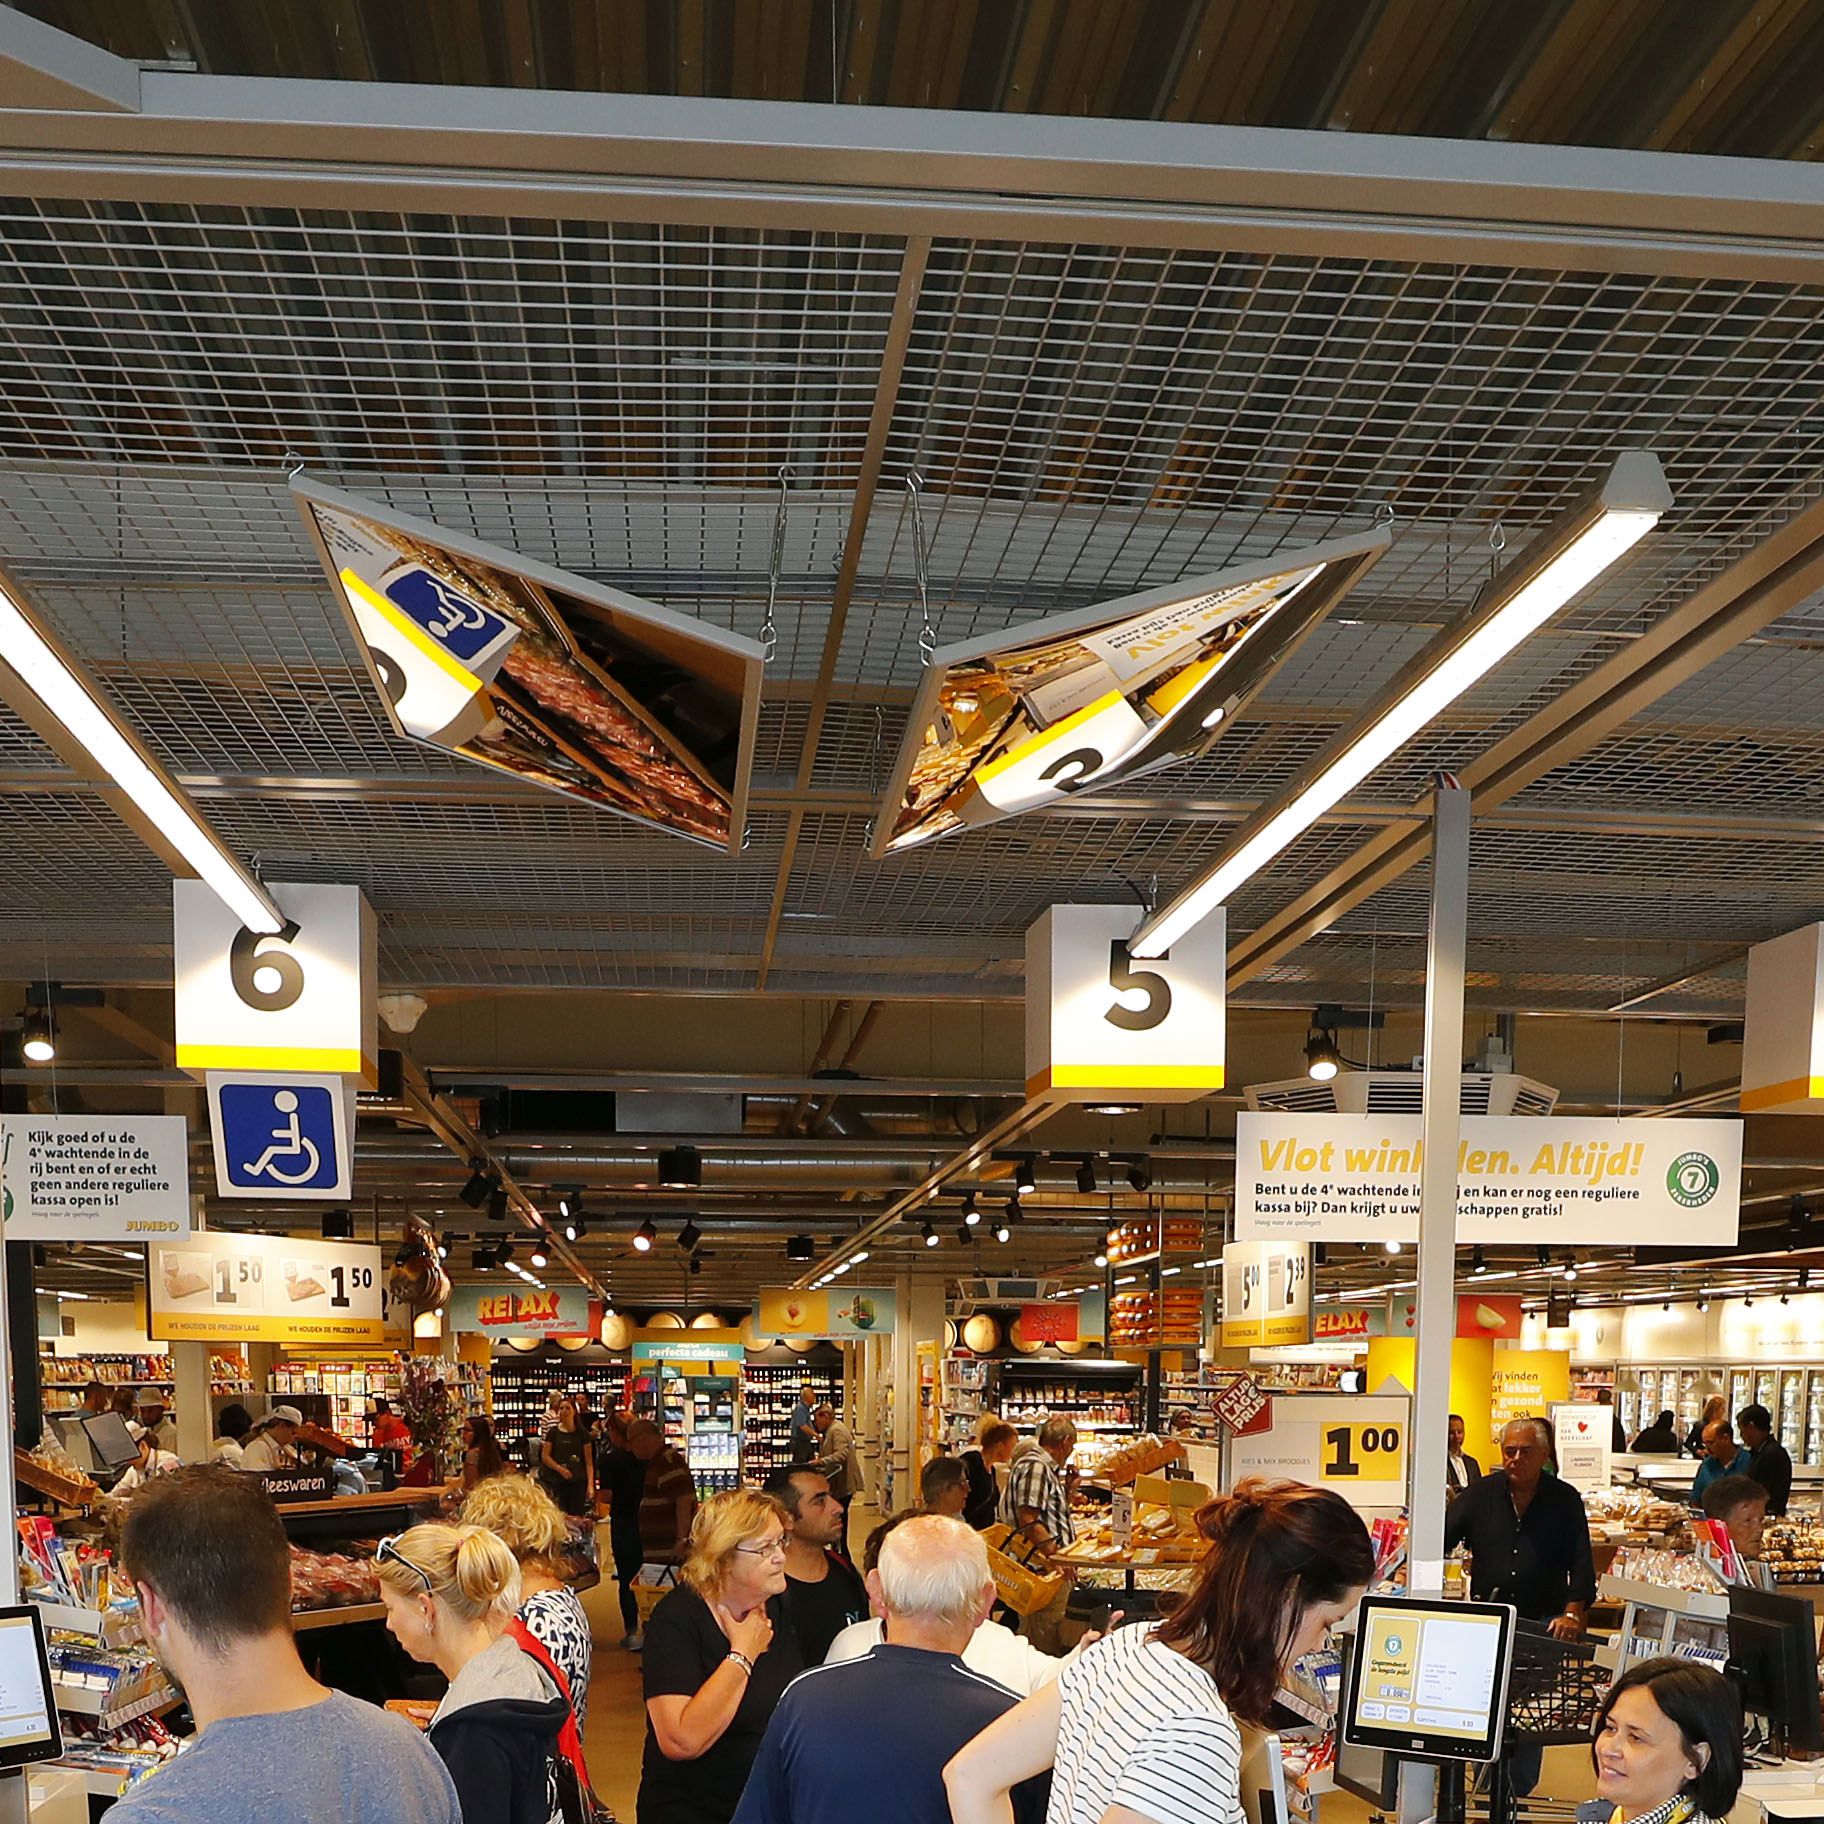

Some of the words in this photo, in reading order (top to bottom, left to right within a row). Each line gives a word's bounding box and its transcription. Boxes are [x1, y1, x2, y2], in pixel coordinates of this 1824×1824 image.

[230, 920, 305, 1012] 6
[1104, 940, 1172, 1031] 5
[28, 1132, 53, 1145] Kijk
[57, 1132, 88, 1146] goed
[91, 1131, 105, 1143] of
[108, 1134, 116, 1143] u
[120, 1132, 135, 1143] de
[45, 1147, 115, 1159] wachtende
[118, 1147, 130, 1159] in
[133, 1148, 149, 1159] de
[1260, 1138, 1334, 1172] Vlot
[1529, 1141, 1645, 1185] Altijd!
[30, 1163, 43, 1177] rij
[46, 1163, 76, 1174] bent
[79, 1165, 94, 1174] en
[97, 1163, 111, 1174] of
[114, 1165, 127, 1174] er
[130, 1164, 157, 1175] echt
[30, 1180, 62, 1192] geen
[65, 1179, 109, 1190] andere
[112, 1179, 169, 1193] reguliere
[1687, 1171, 1699, 1189] 7
[1255, 1183, 1286, 1195] Bent
[1289, 1186, 1297, 1195] u
[1301, 1183, 1317, 1195] de
[1337, 1183, 1409, 1196] wachtende
[1464, 1189, 1479, 1198] en
[1483, 1186, 1507, 1198] kan
[1511, 1189, 1524, 1198] er
[1527, 1189, 1551, 1201] nog
[1555, 1190, 1578, 1199] een
[1582, 1187, 1639, 1201] reguliere
[31, 1194, 66, 1205] kassa
[69, 1195, 101, 1208] open
[105, 1194, 119, 1206] is!
[1255, 1201, 1290, 1213] kassa
[1295, 1202, 1317, 1217] bij?
[1321, 1202, 1346, 1213] Dan
[1351, 1203, 1386, 1218] krijgt
[1390, 1205, 1397, 1213] u
[1401, 1204, 1420, 1214] uw
[1522, 1204, 1562, 1218] gratis!
[126, 1221, 179, 1232] JUMBO
[1315, 1311, 1369, 1337] ELAX
[649, 1348, 690, 1358] perfecte
[692, 1349, 728, 1357] cadeau
[1505, 1372, 1538, 1381] vinden
[1504, 1383, 1542, 1393] lekker
[1219, 1379, 1251, 1415] ALTIJD
[1225, 1388, 1258, 1422] LAGE
[1500, 1397, 1543, 1408] gezond
[1234, 1398, 1266, 1430] PRIJS
[1513, 1410, 1531, 1419] ook
[262, 1477, 325, 1494] leeswaren
